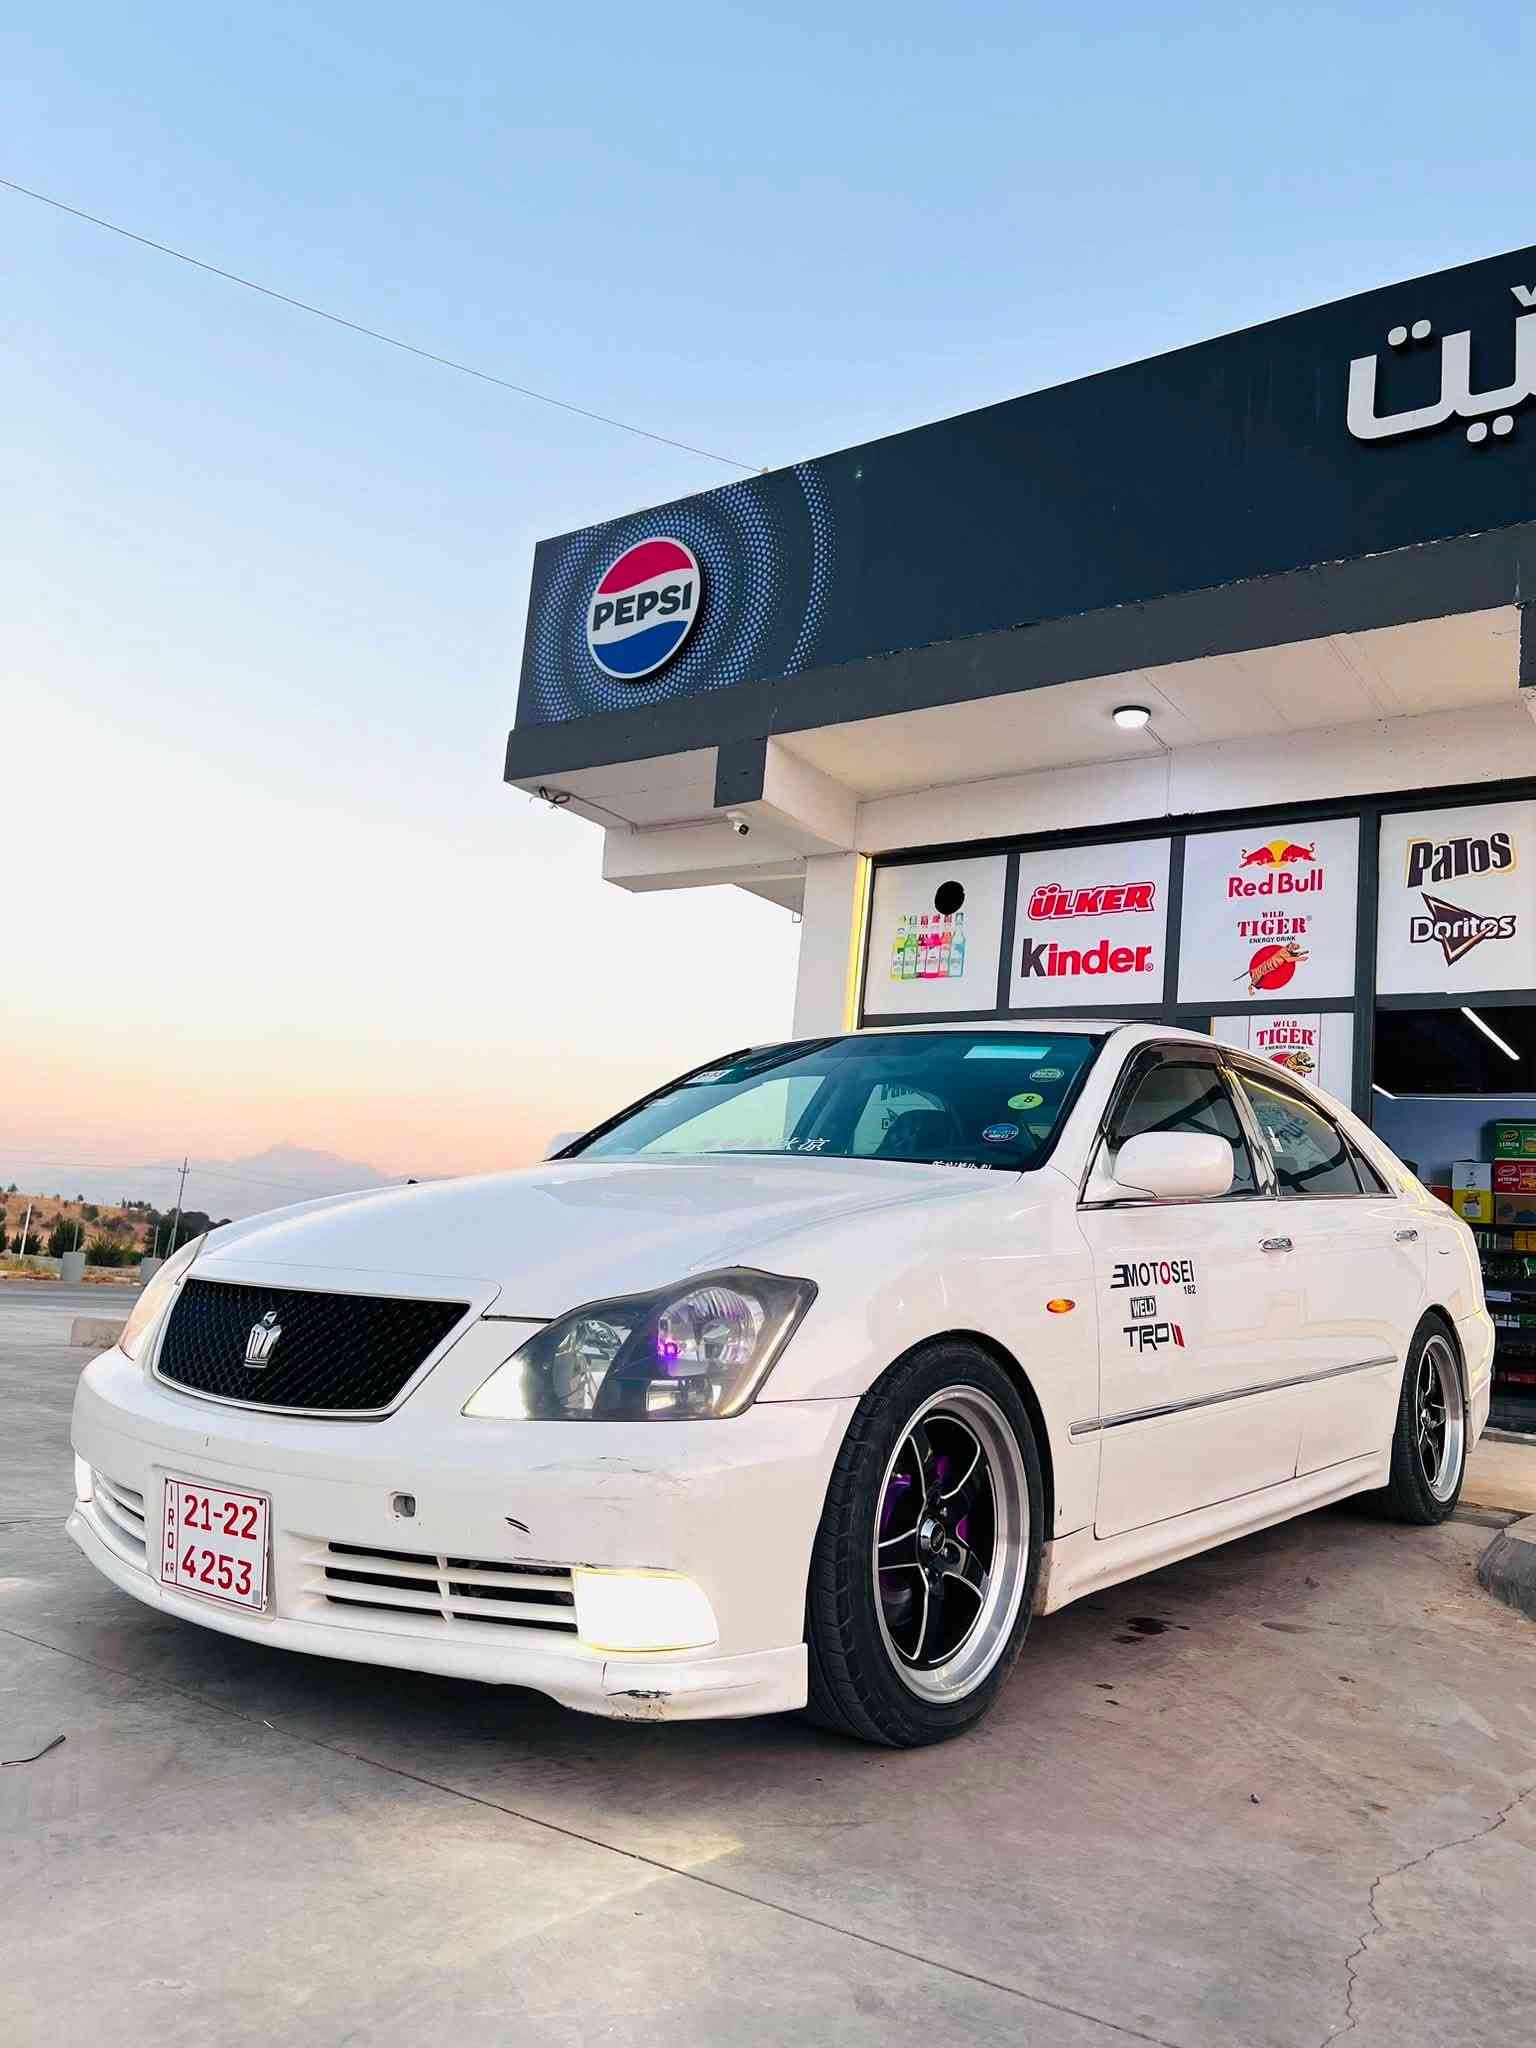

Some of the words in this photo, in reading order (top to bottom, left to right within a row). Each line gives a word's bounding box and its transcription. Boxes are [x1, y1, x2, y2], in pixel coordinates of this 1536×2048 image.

[592, 581, 694, 632] PEPSI
[1228, 872, 1273, 898] Red
[1277, 869, 1324, 895] Bull
[1029, 882, 1155, 920] ÜLKER
[1261, 910, 1284, 919] WILD
[1237, 917, 1306, 937] TIGER
[1276, 935, 1296, 943] DRINK
[1411, 916, 1516, 943] Doritos
[1020, 938, 1152, 978] Kinder
[1273, 1020, 1297, 1028] WILD
[1256, 1028, 1314, 1046] TIGER
[1183, 1285, 1197, 1295] 182
[1131, 1297, 1156, 1318] WELD
[184, 1494, 258, 1540] 21-22
[182, 1545, 252, 1595] 4253
